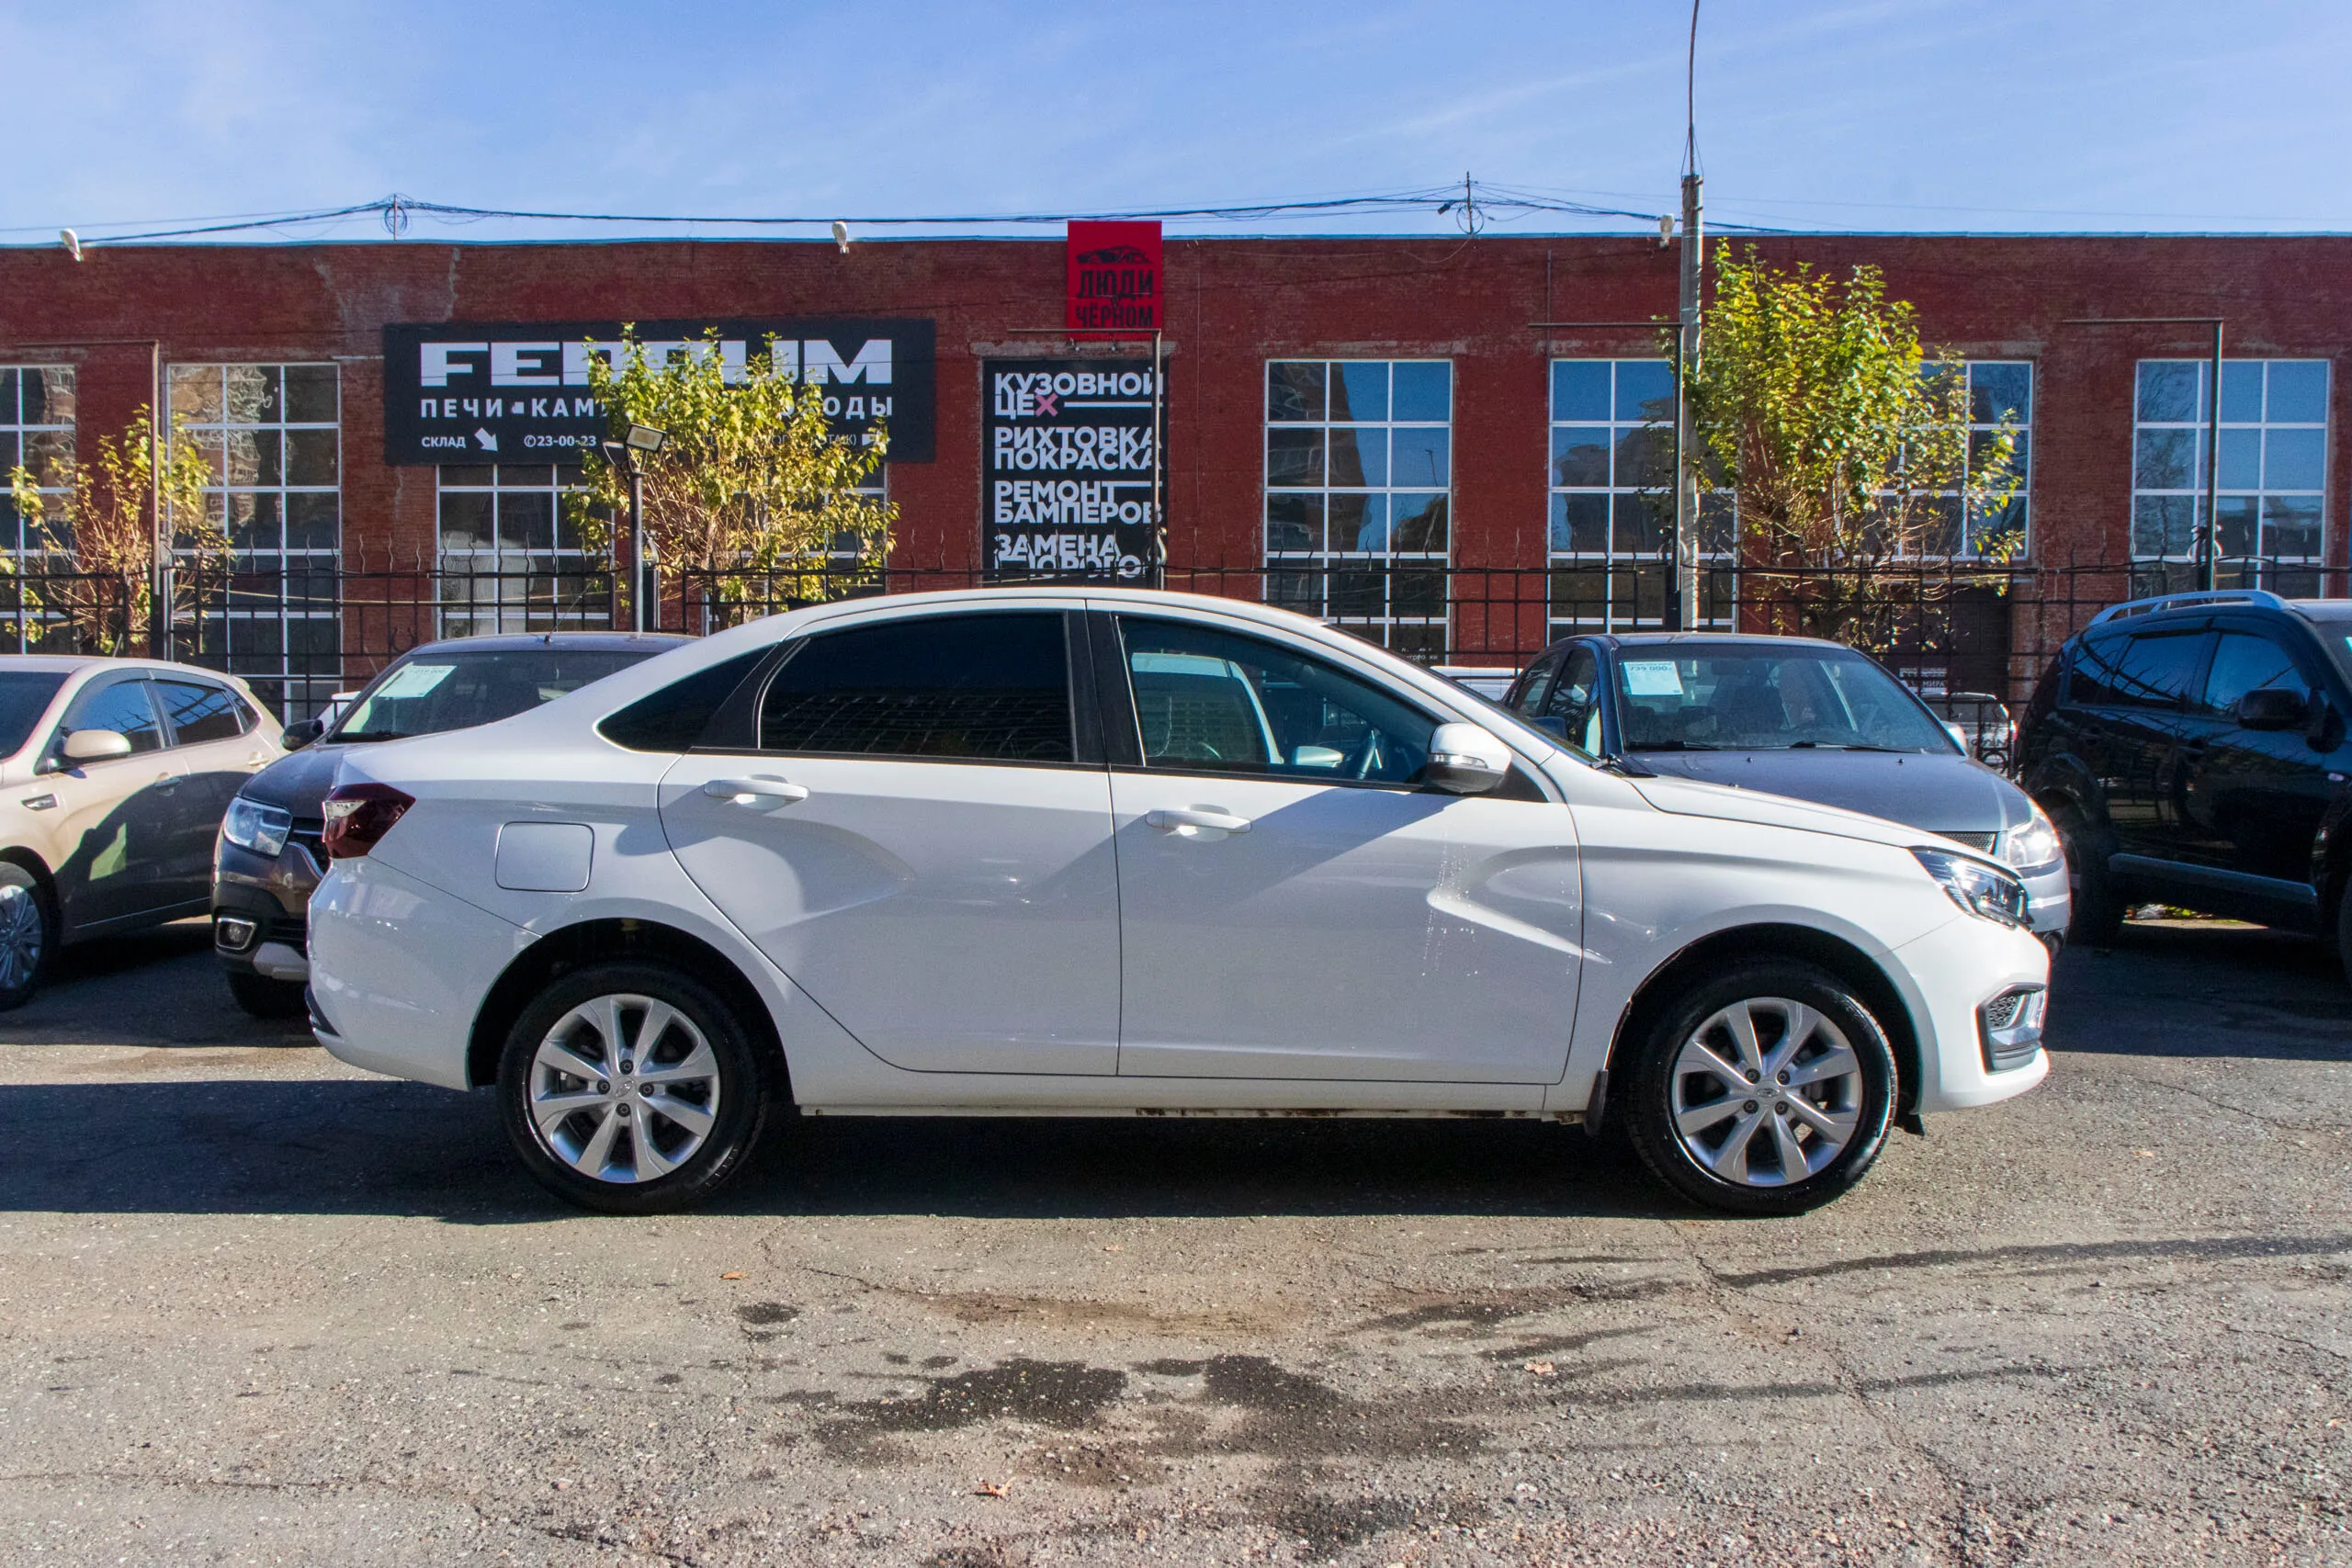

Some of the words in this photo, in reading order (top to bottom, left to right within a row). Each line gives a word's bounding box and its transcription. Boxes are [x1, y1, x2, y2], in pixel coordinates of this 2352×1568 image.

[1077, 270, 1154, 301] ЛЮДИ
[1076, 302, 1154, 328] ЧЁРНОМ
[994, 367, 1163, 396] КУЗОВНОЙ
[420, 398, 503, 419] ПЕЧИ
[994, 393, 1058, 421] ЦЕХ
[421, 435, 467, 449] СКЛАД
[537, 434, 597, 448] 23-00-23
[994, 426, 1162, 449] РИХТОВКА
[994, 446, 1162, 470] ПОКРАСКА
[994, 479, 1162, 505] РЕМОНТ
[994, 501, 1162, 525] БАМПЕРОВ
[994, 534, 1122, 557] ЗАМЕНА
